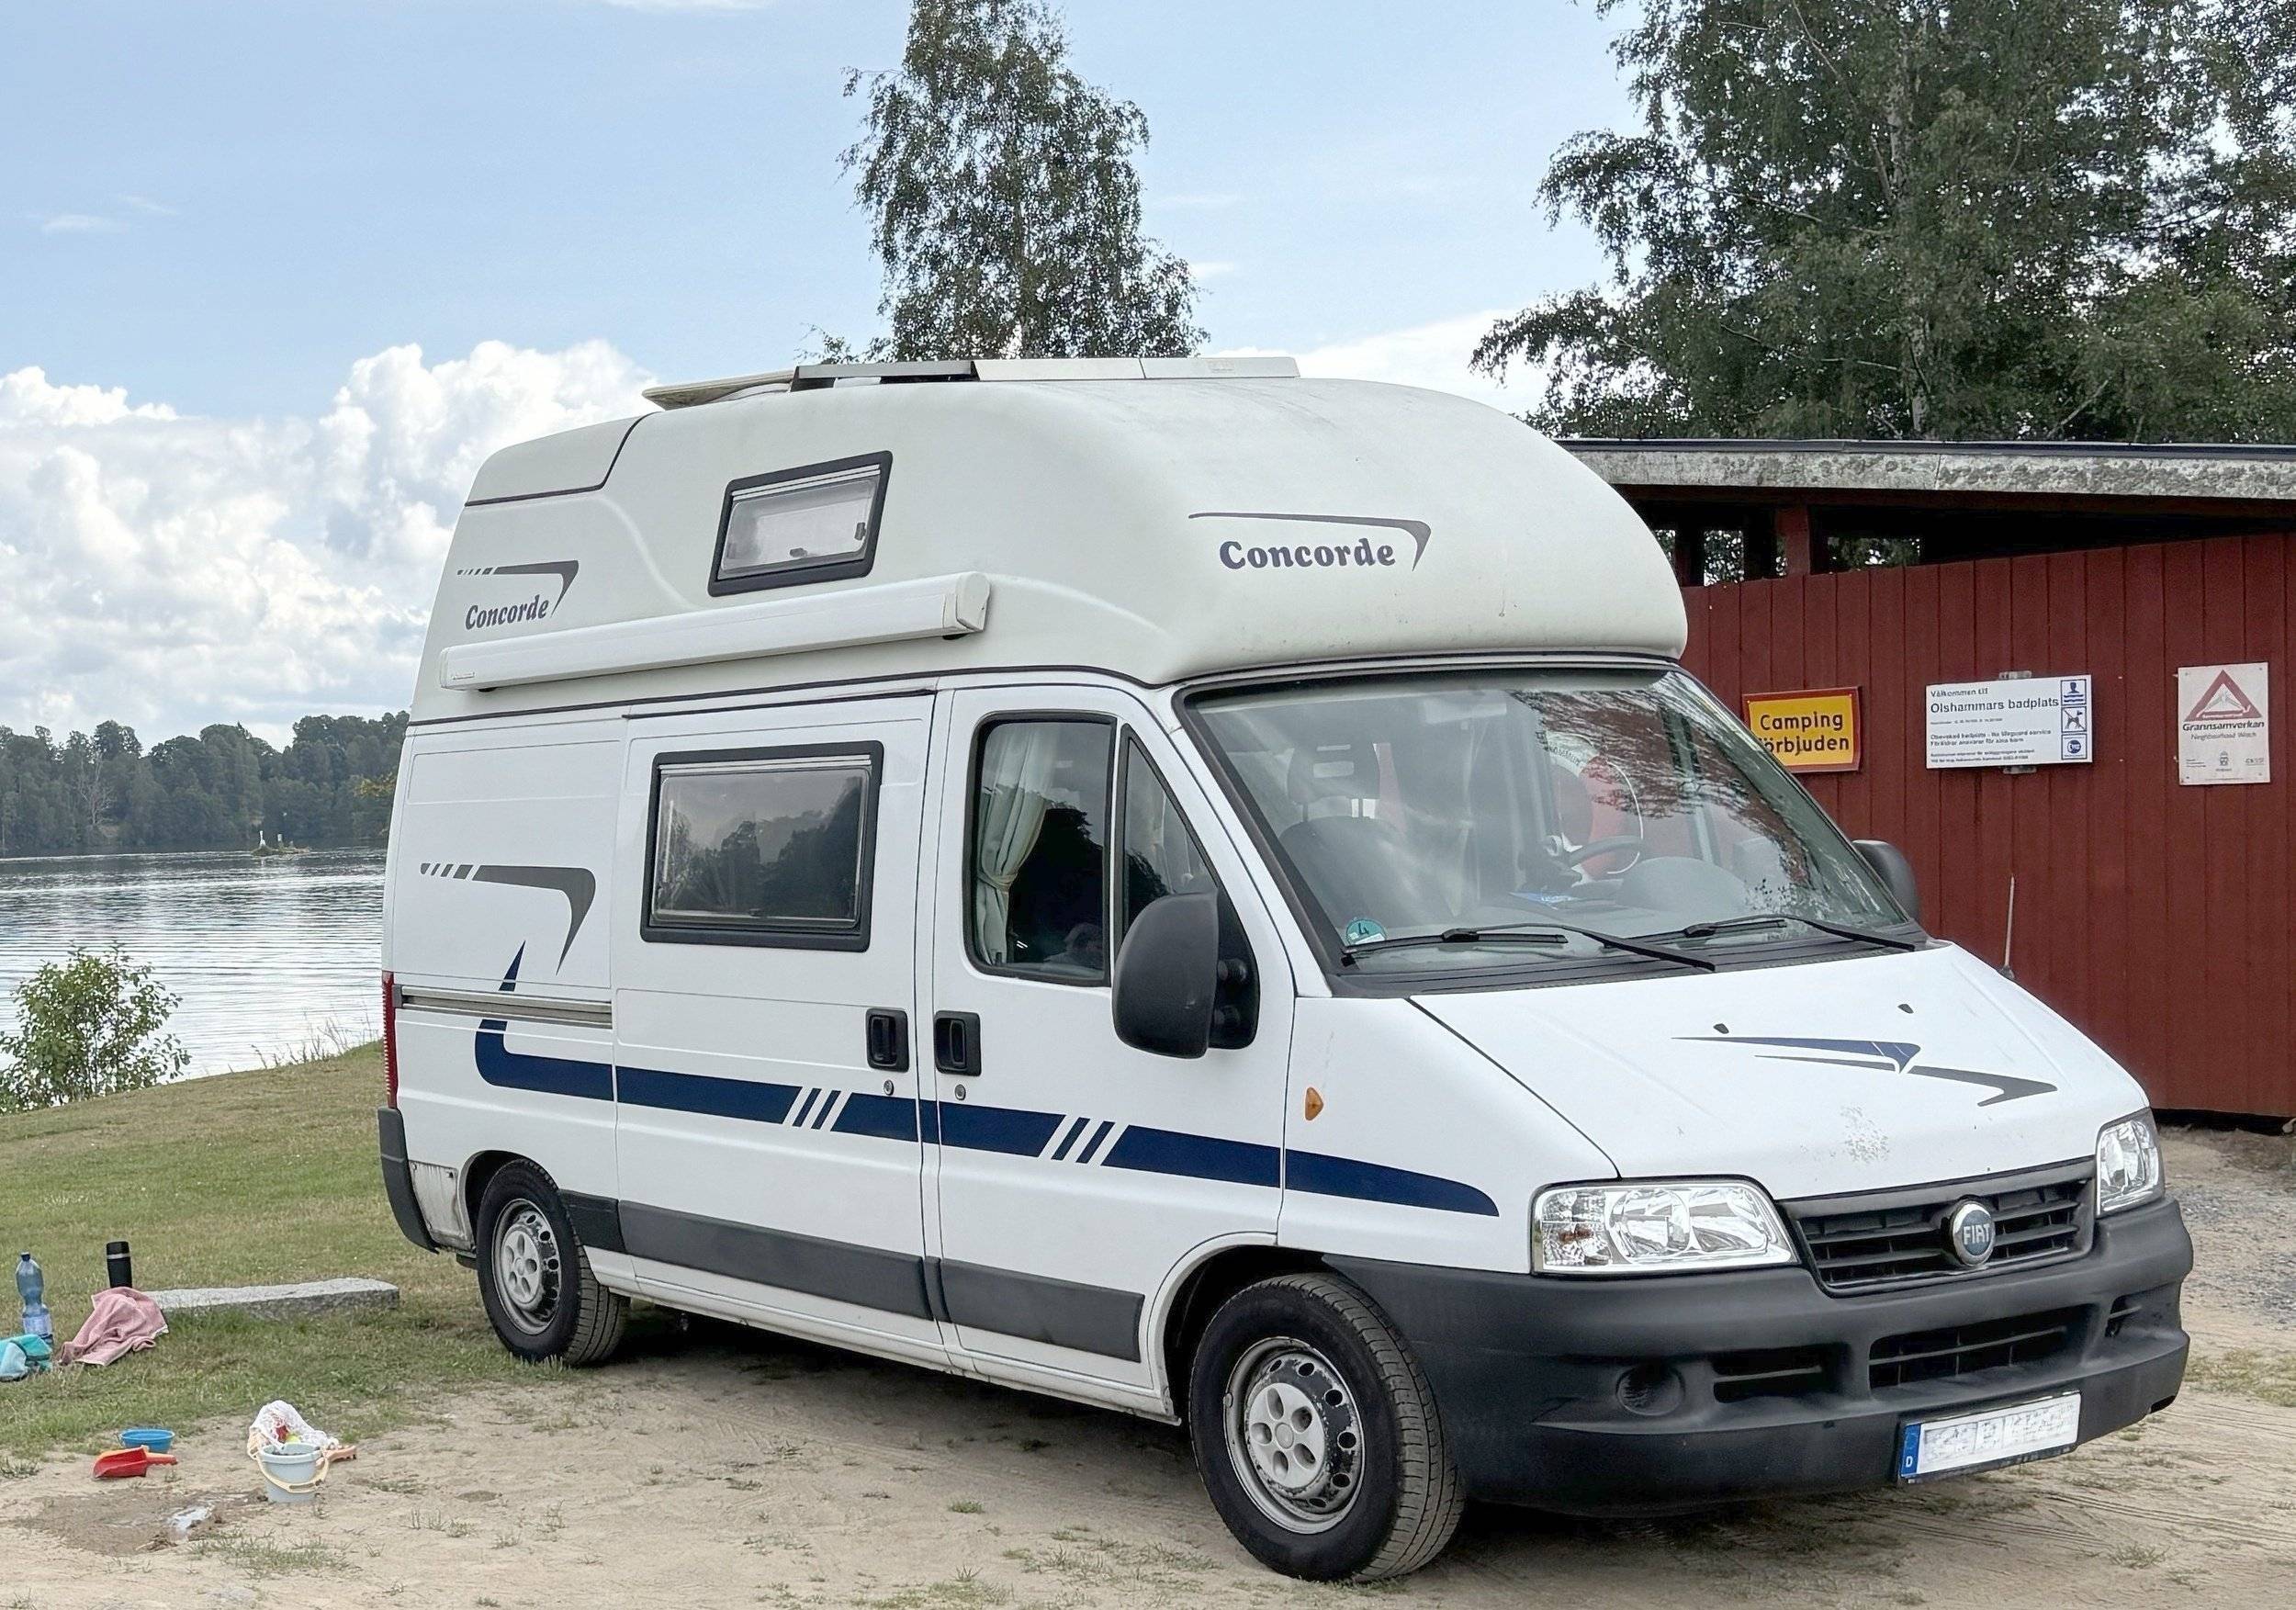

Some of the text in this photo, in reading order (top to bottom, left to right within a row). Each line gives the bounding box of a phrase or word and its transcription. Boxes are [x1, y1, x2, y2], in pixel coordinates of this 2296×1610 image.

[1219, 537, 1396, 570] Concorde
[465, 593, 550, 631] Concorde
[1930, 697, 2059, 714] Olshammars badplats
[1760, 711, 1843, 732] Camping
[2182, 720, 2265, 731] Grannsamverkan
[1759, 735, 1850, 756] örbjuden
[1357, 922, 1370, 935] 4
[1963, 1222, 1990, 1245] FIAT
[1905, 1456, 1914, 1468] D
